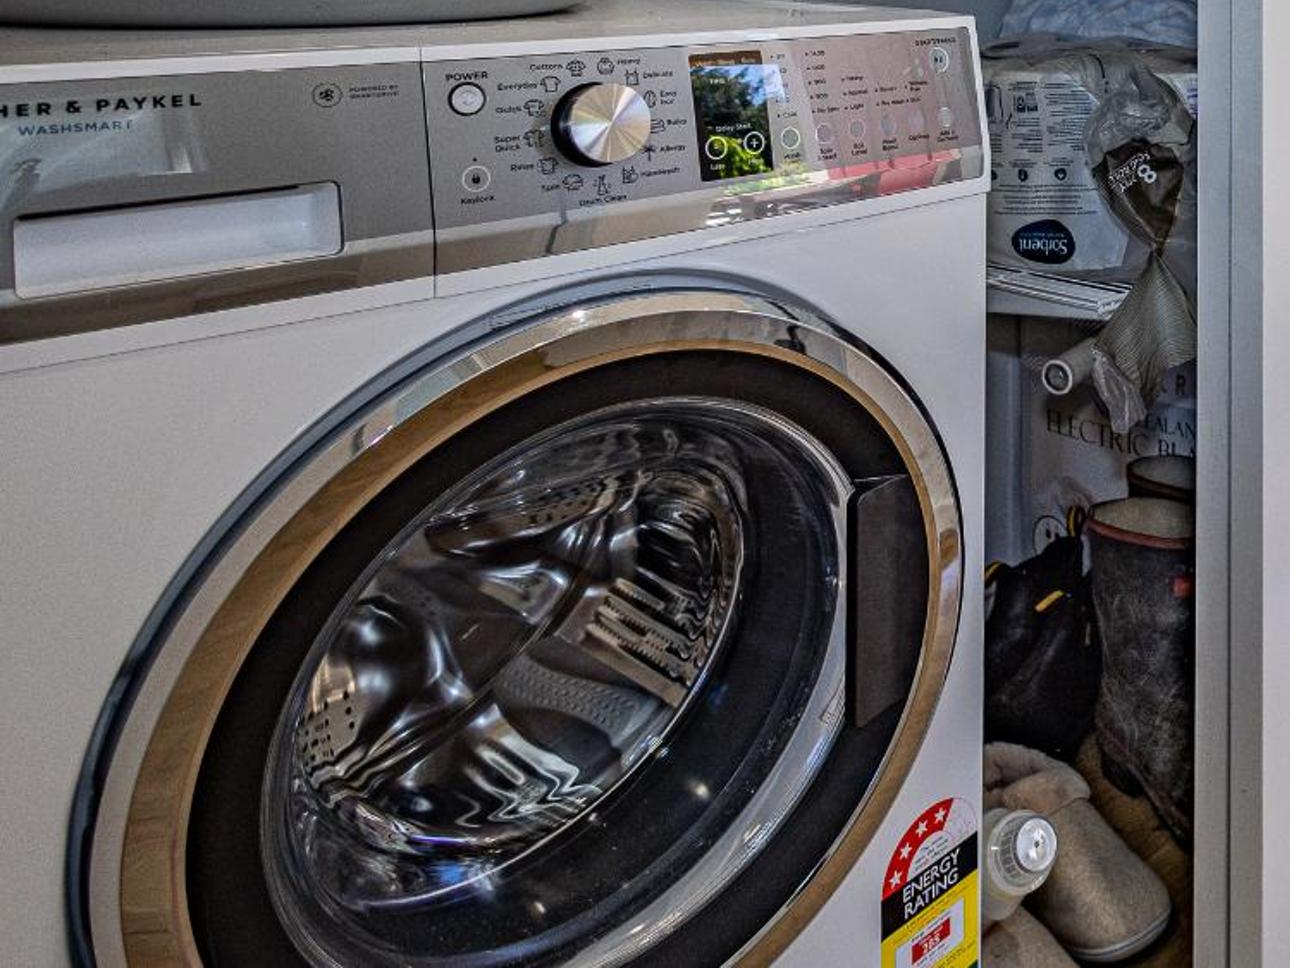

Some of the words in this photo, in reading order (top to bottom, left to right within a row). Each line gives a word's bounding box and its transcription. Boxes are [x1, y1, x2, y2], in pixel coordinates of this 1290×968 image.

[445, 71, 489, 81] POWER
[66, 100, 81, 113] &
[96, 94, 202, 112] PAYKEL
[18, 120, 133, 136] WASHSMART
[1019, 238, 1068, 256] Sorbent
[1047, 409, 1150, 456] ELECTRIC
[902, 848, 960, 903] ENERGY
[904, 868, 959, 919] RATING
